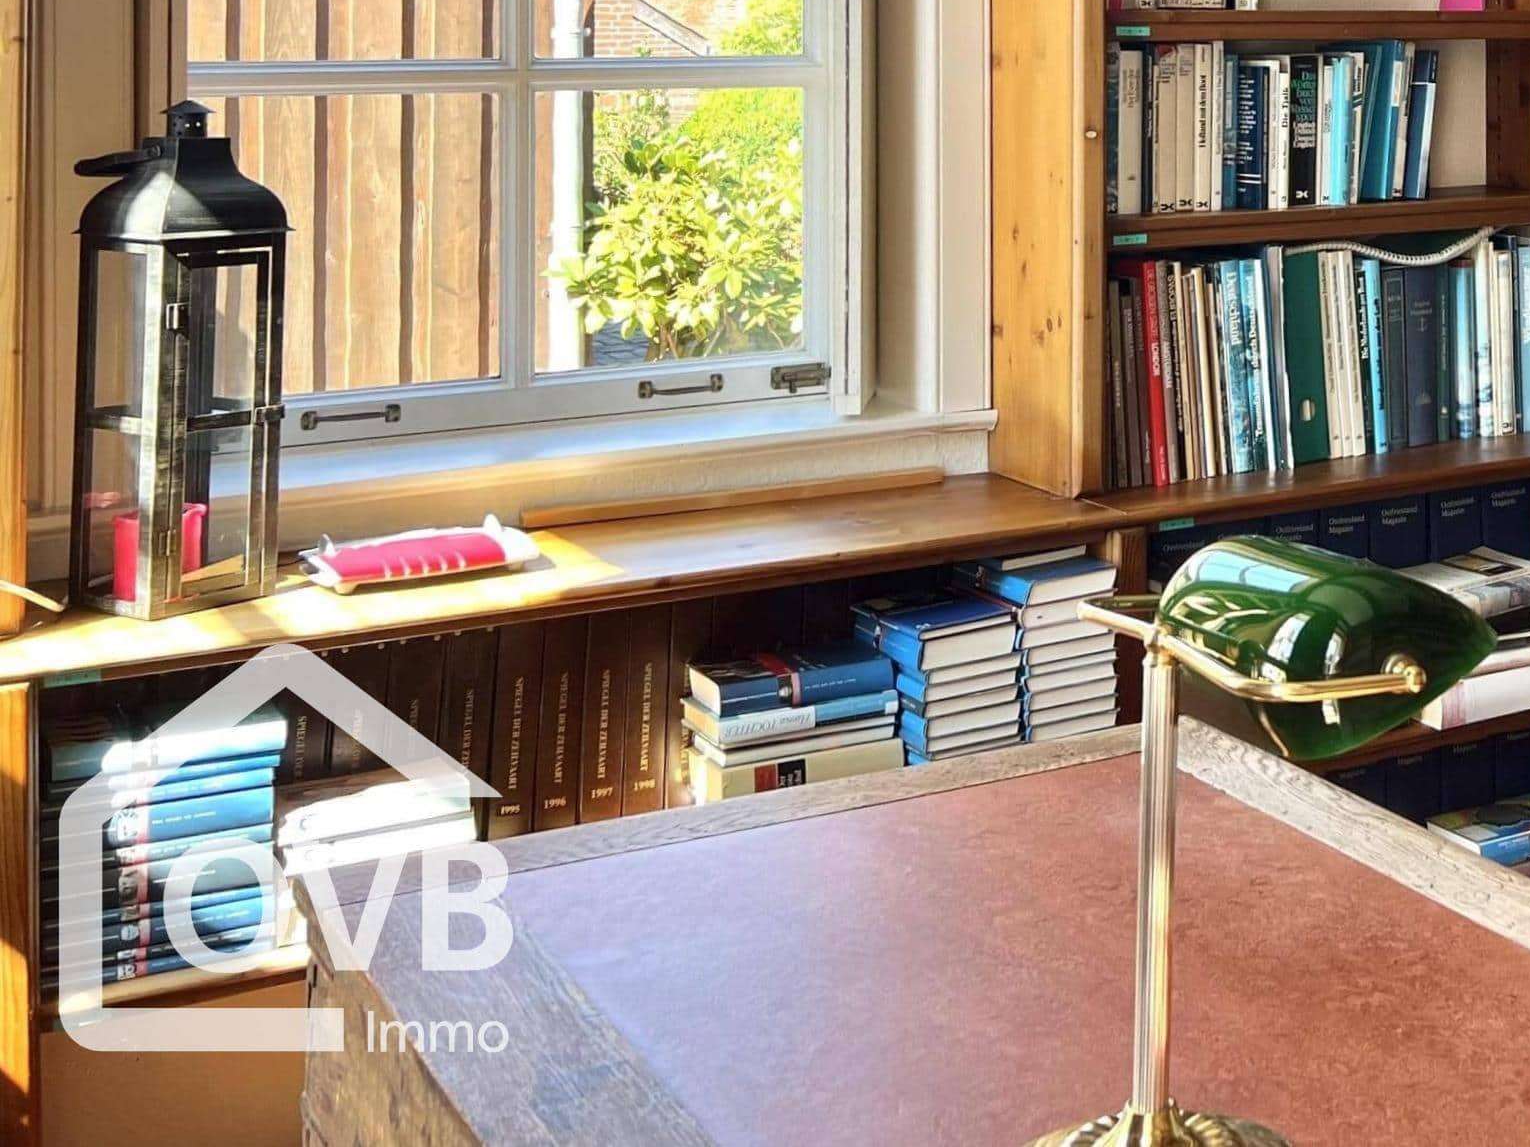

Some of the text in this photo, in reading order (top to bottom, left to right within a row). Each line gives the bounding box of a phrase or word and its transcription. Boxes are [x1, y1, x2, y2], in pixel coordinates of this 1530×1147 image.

[1198, 120, 1206, 148] Holland
[1226, 271, 1242, 346] Deutschland
[1152, 342, 1160, 375] LONDON
[556, 672, 569, 711] SPIEGEL
[599, 669, 611, 707] SPIEGEL
[641, 663, 653, 701] SPIEGEL
[510, 676, 525, 716] SPIEGEL
[556, 713, 568, 733] DER
[599, 709, 610, 729] DER
[640, 703, 652, 723] DER
[509, 718, 524, 739] DER
[589, 787, 614, 800] 1997
[632, 778, 656, 790] 1998
[499, 804, 521, 814] 1995
[543, 797, 568, 809] 1996
